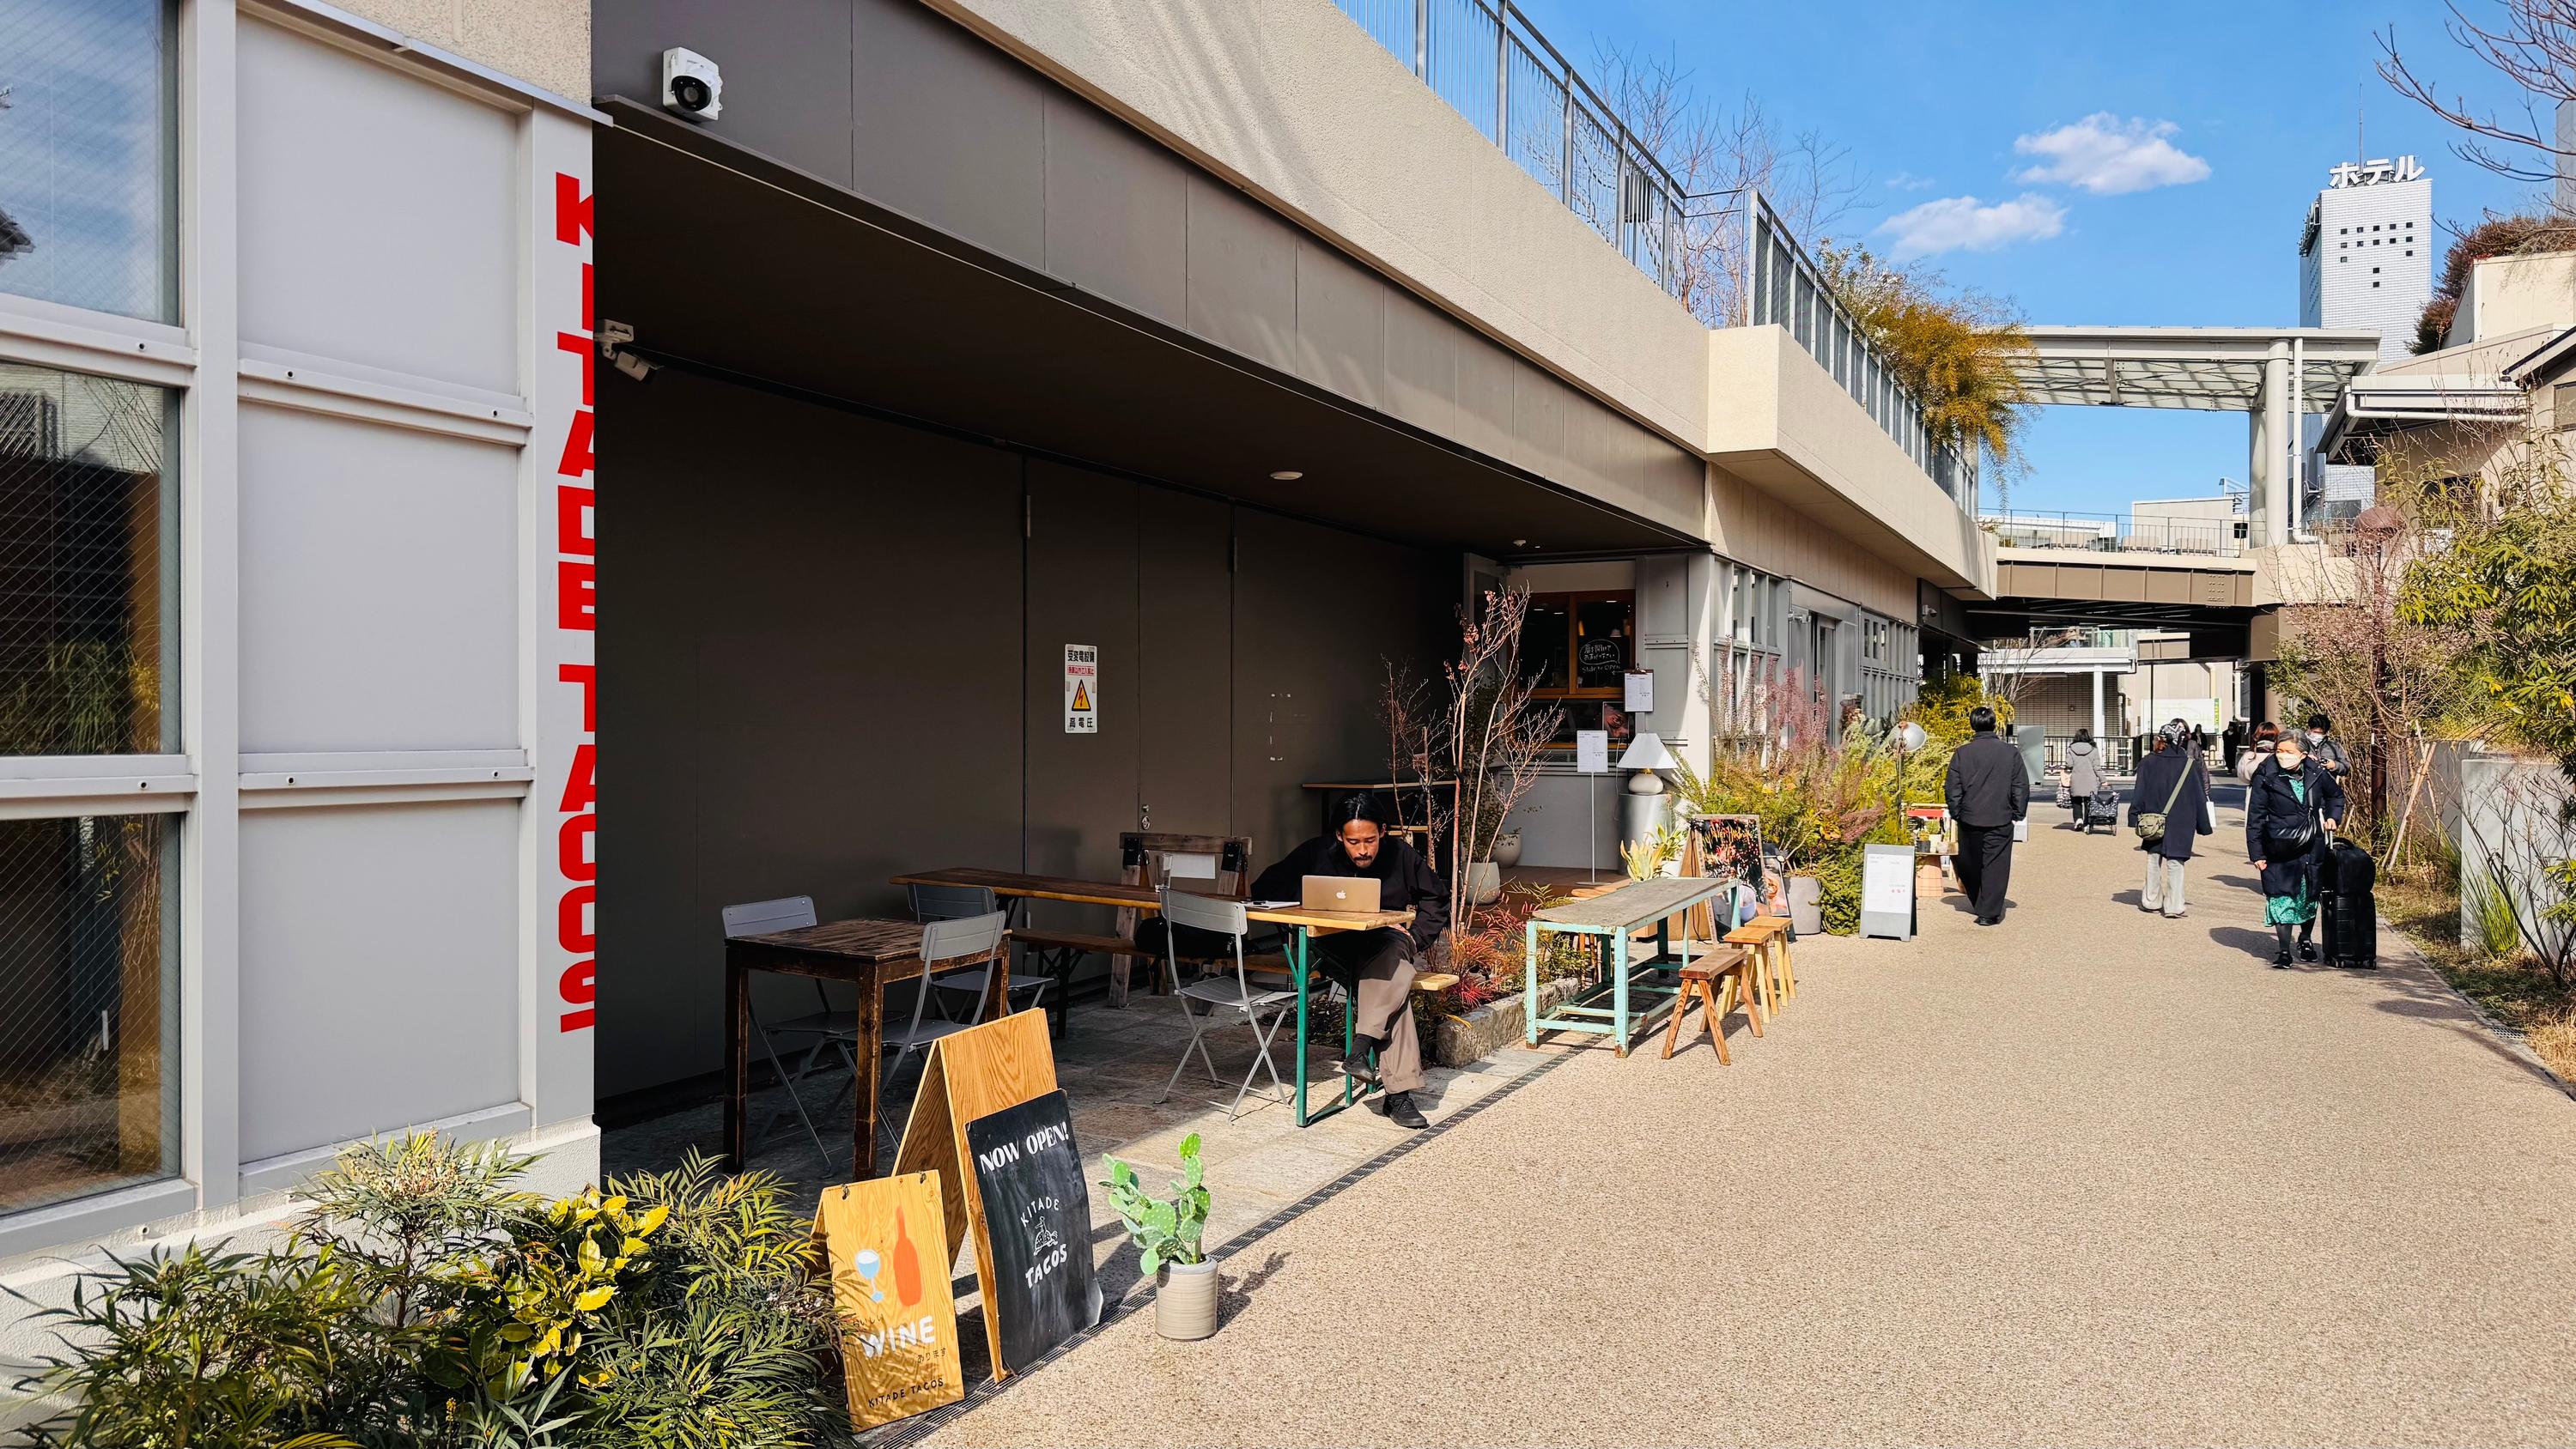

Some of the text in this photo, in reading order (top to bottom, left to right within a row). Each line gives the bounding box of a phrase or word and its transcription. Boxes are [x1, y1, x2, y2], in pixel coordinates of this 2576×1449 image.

[2329, 155, 2426, 189] ホテル
[1067, 650, 1095, 663] 受変電設備
[1069, 717, 1093, 728] 高電圧
[979, 1121, 1069, 1175] NOW OPEN!
[1020, 1196, 1060, 1228] KITADE
[1025, 1243, 1067, 1288] TACOS
[860, 1315, 935, 1358] WINE
[916, 1348, 946, 1364] あります
[868, 1378, 944, 1408] KITADE TACOS
